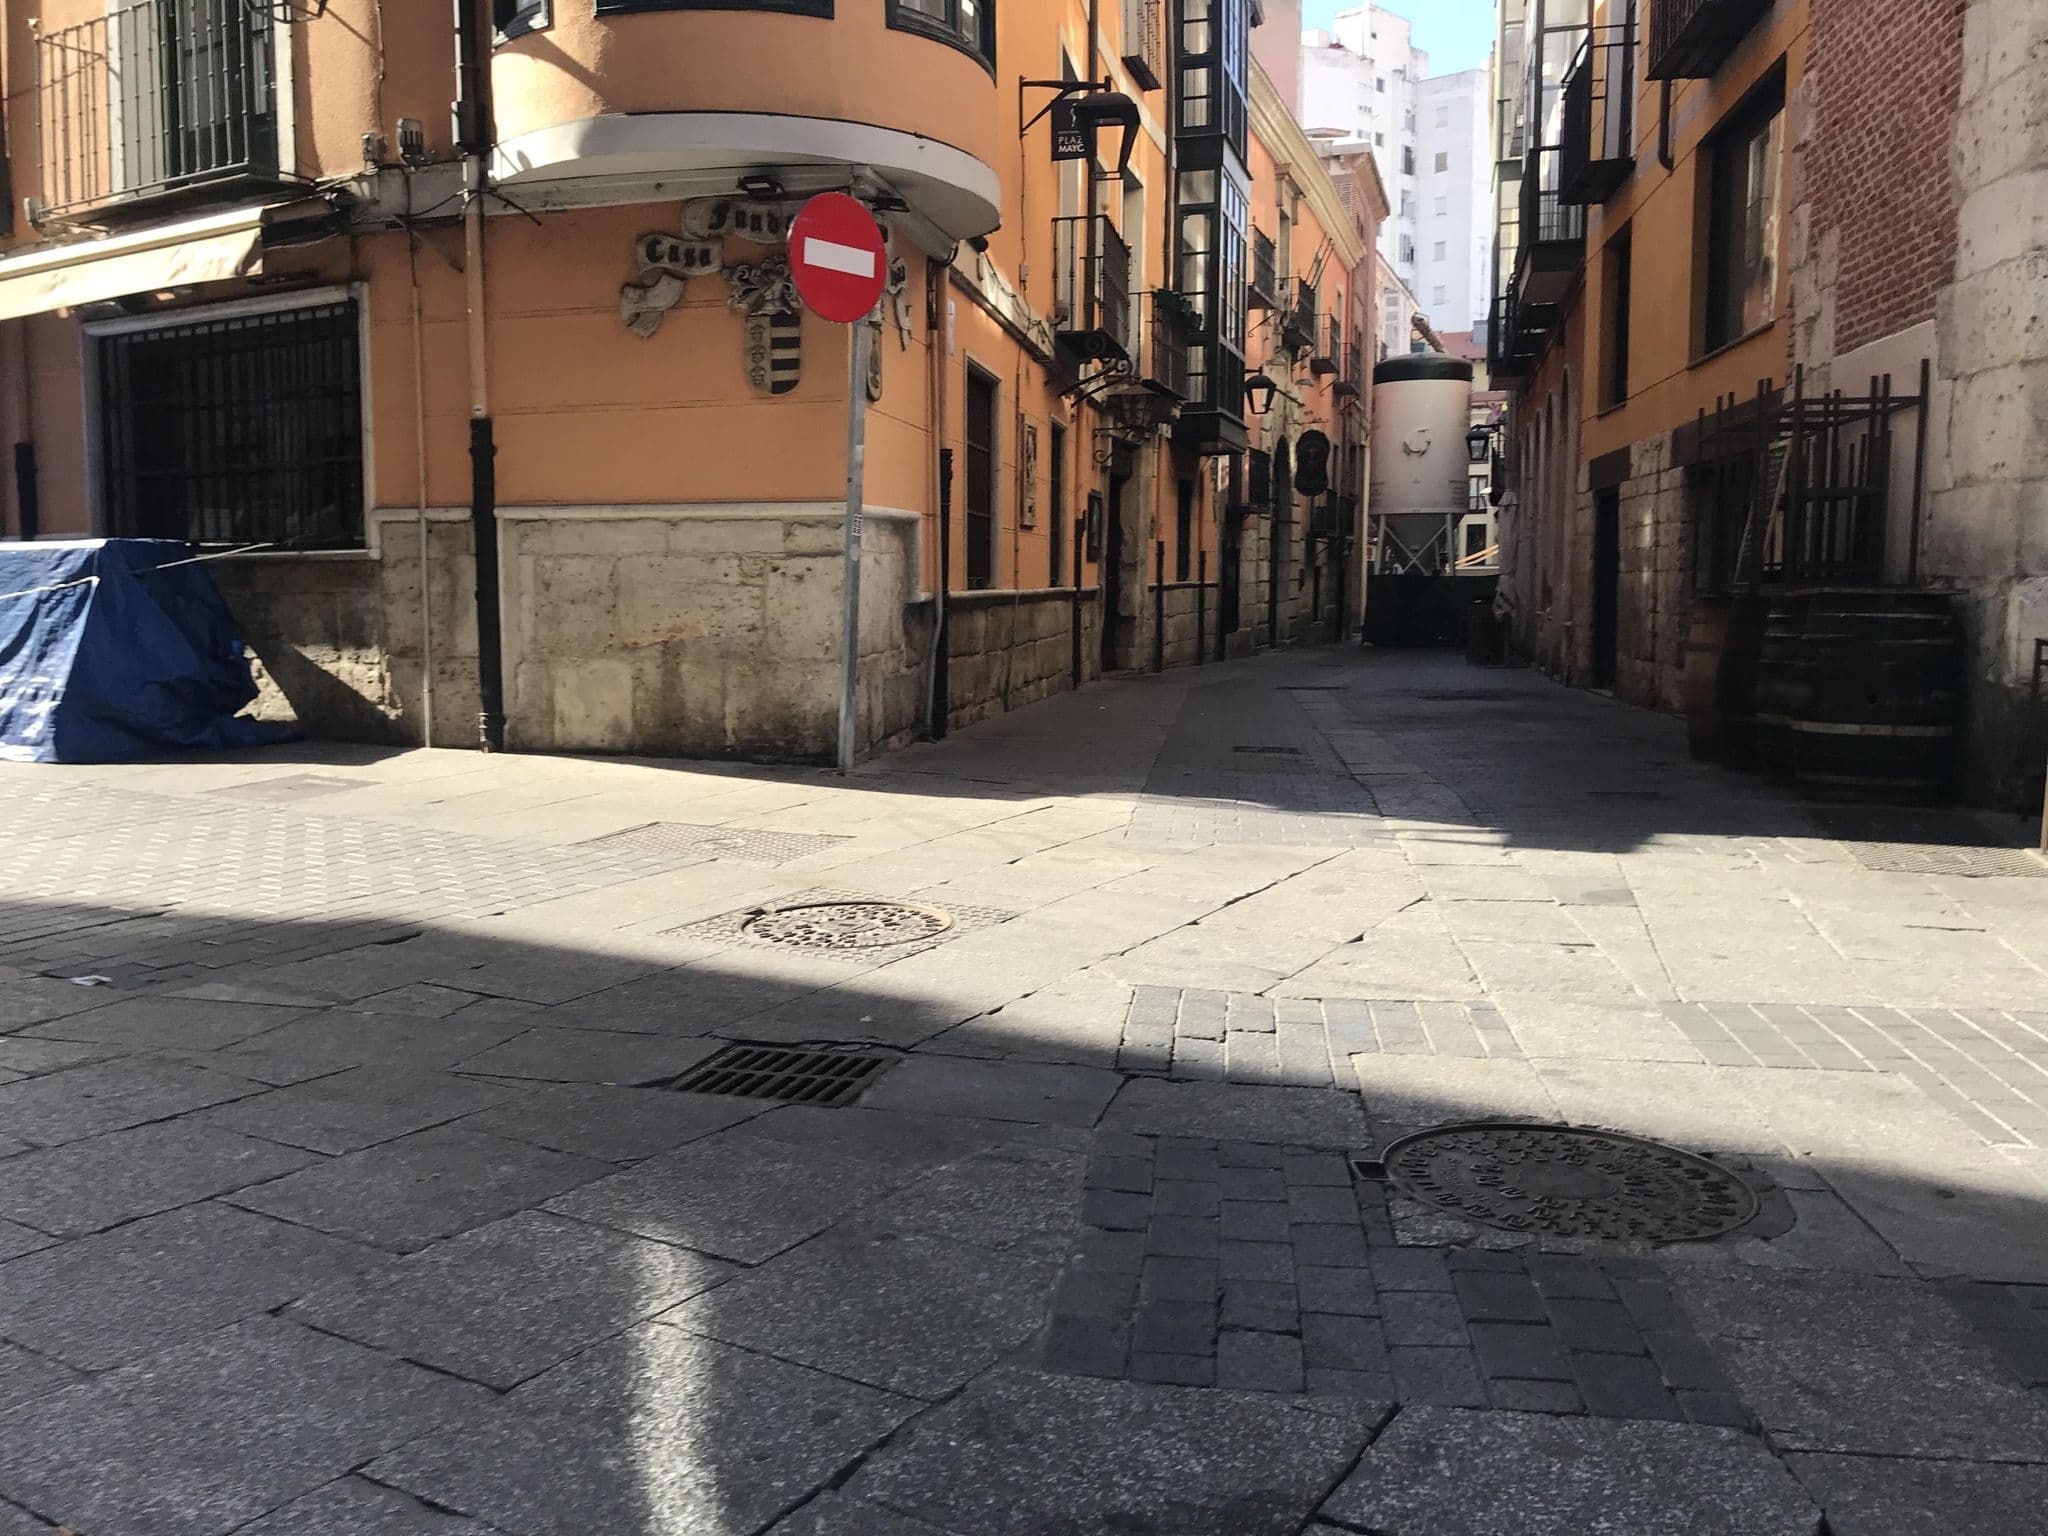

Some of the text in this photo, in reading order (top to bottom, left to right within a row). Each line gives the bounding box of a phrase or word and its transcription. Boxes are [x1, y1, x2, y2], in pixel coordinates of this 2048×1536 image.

[1058, 136, 1083, 144] PLAZ
[1058, 144, 1085, 152] MAYO
[646, 239, 711, 267] Casa
